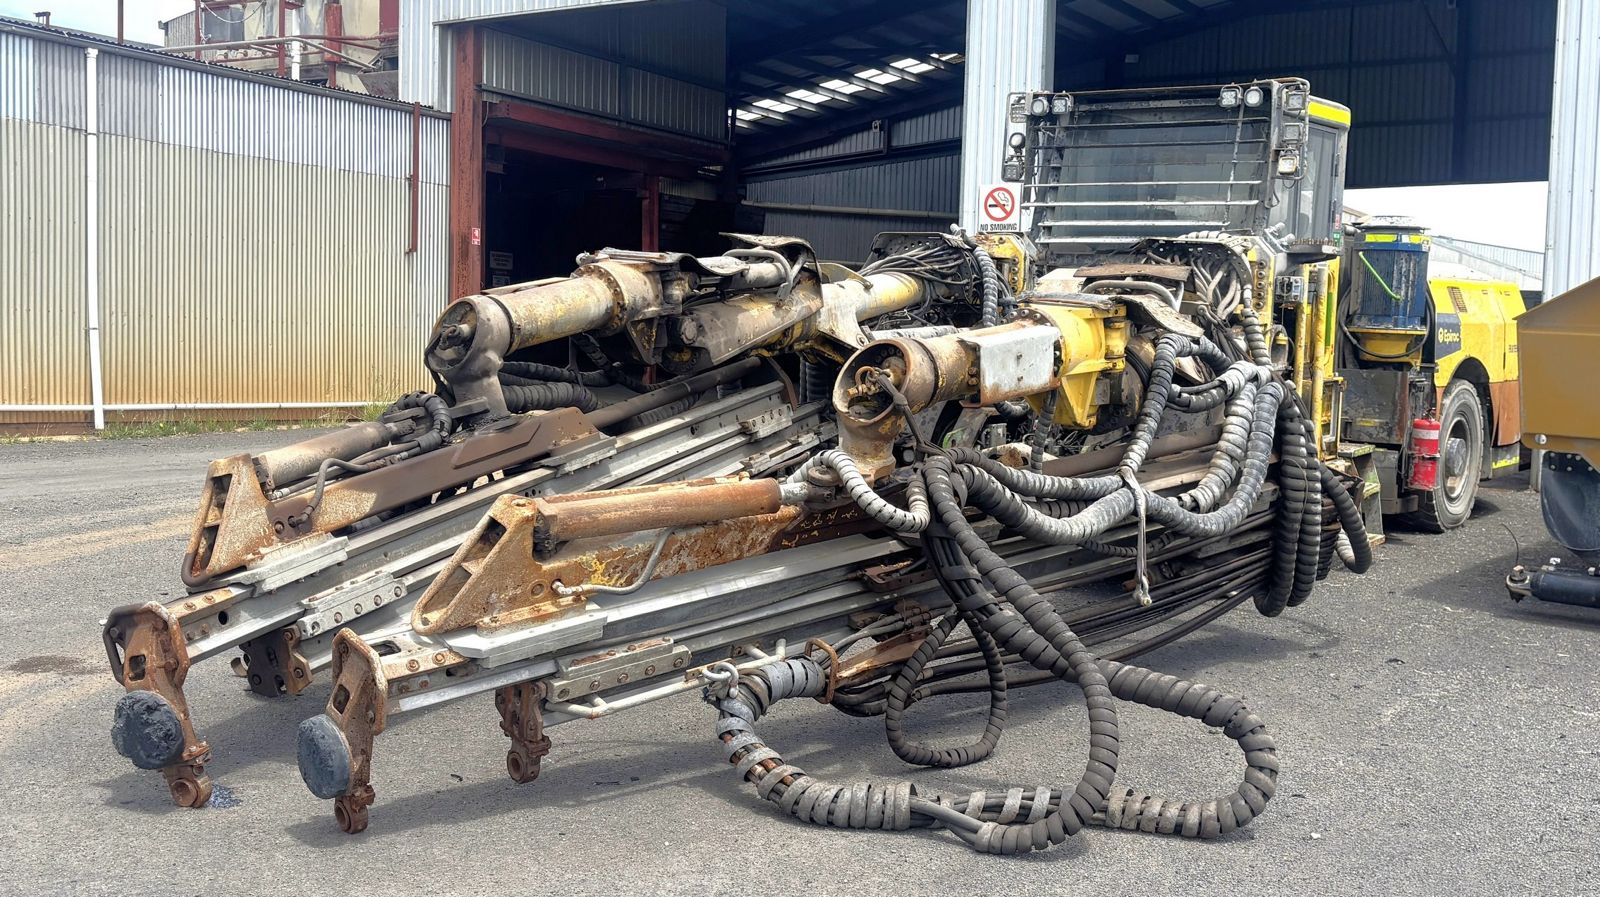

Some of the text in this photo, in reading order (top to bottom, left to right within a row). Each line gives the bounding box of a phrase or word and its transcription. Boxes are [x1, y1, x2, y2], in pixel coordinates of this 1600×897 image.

[980, 223, 1017, 231] NO SMOKING
[1444, 329, 1460, 345] Epiroc
